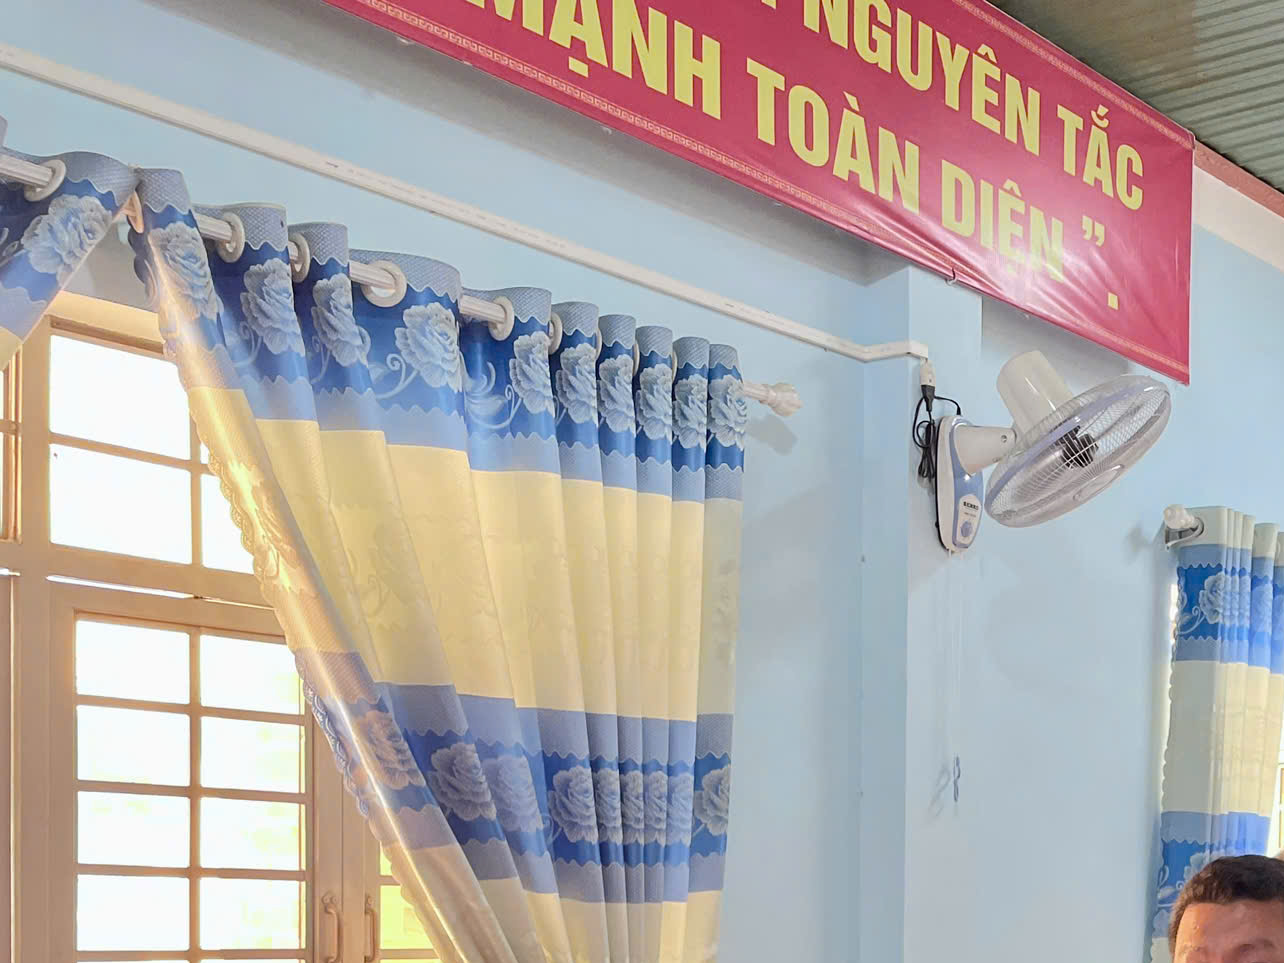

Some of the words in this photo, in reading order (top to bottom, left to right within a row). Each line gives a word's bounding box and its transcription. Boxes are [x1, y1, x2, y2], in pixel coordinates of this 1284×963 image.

[465, 0, 721, 121] ẠNH
[746, 57, 921, 215] TOÀN
[941, 159, 1067, 284] DIỆN
[803, 0, 1041, 156] NGUYÊN
[1056, 104, 1144, 211] TẮC
